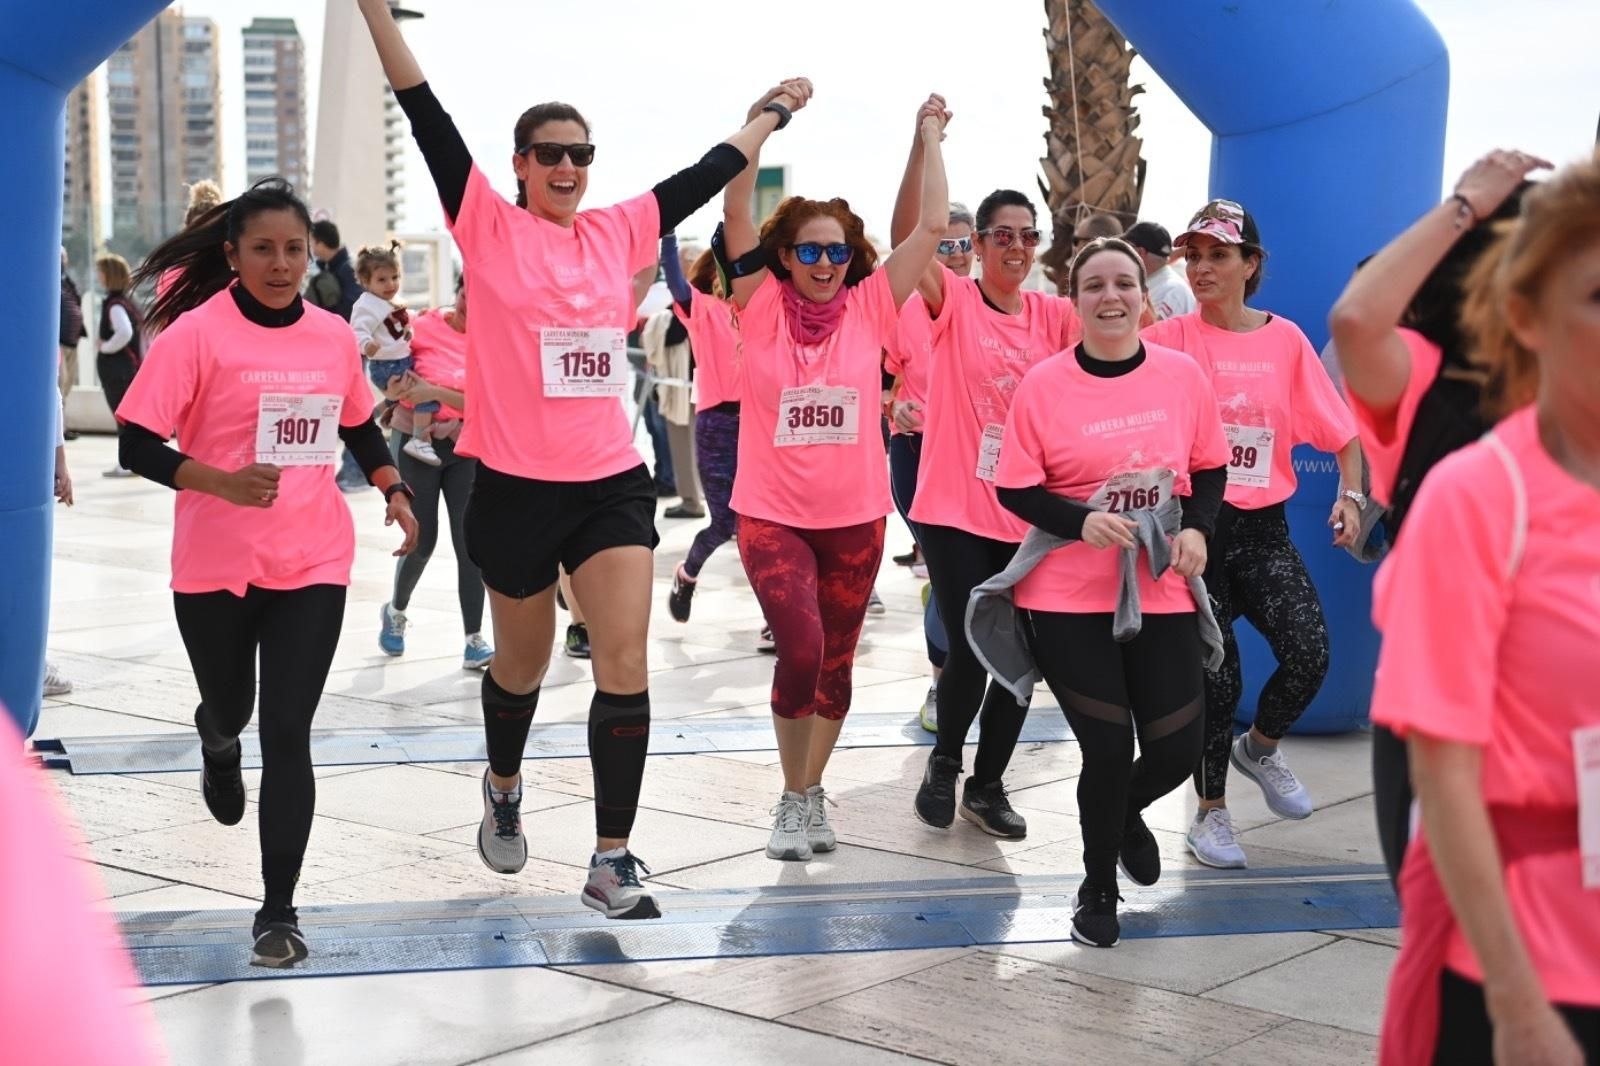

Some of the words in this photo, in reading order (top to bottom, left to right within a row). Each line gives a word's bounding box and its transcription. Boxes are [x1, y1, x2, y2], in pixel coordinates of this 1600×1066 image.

[240, 370, 286, 384] CARRERA
[287, 370, 327, 384] MUJERES
[560, 352, 611, 377] 1758
[788, 405, 844, 429] 3850
[1081, 417, 1126, 436] CARRERA
[1126, 408, 1168, 426] MUJERES
[273, 418, 320, 444] 1907
[1229, 445, 1258, 469] 89
[1105, 485, 1159, 513] 2766
